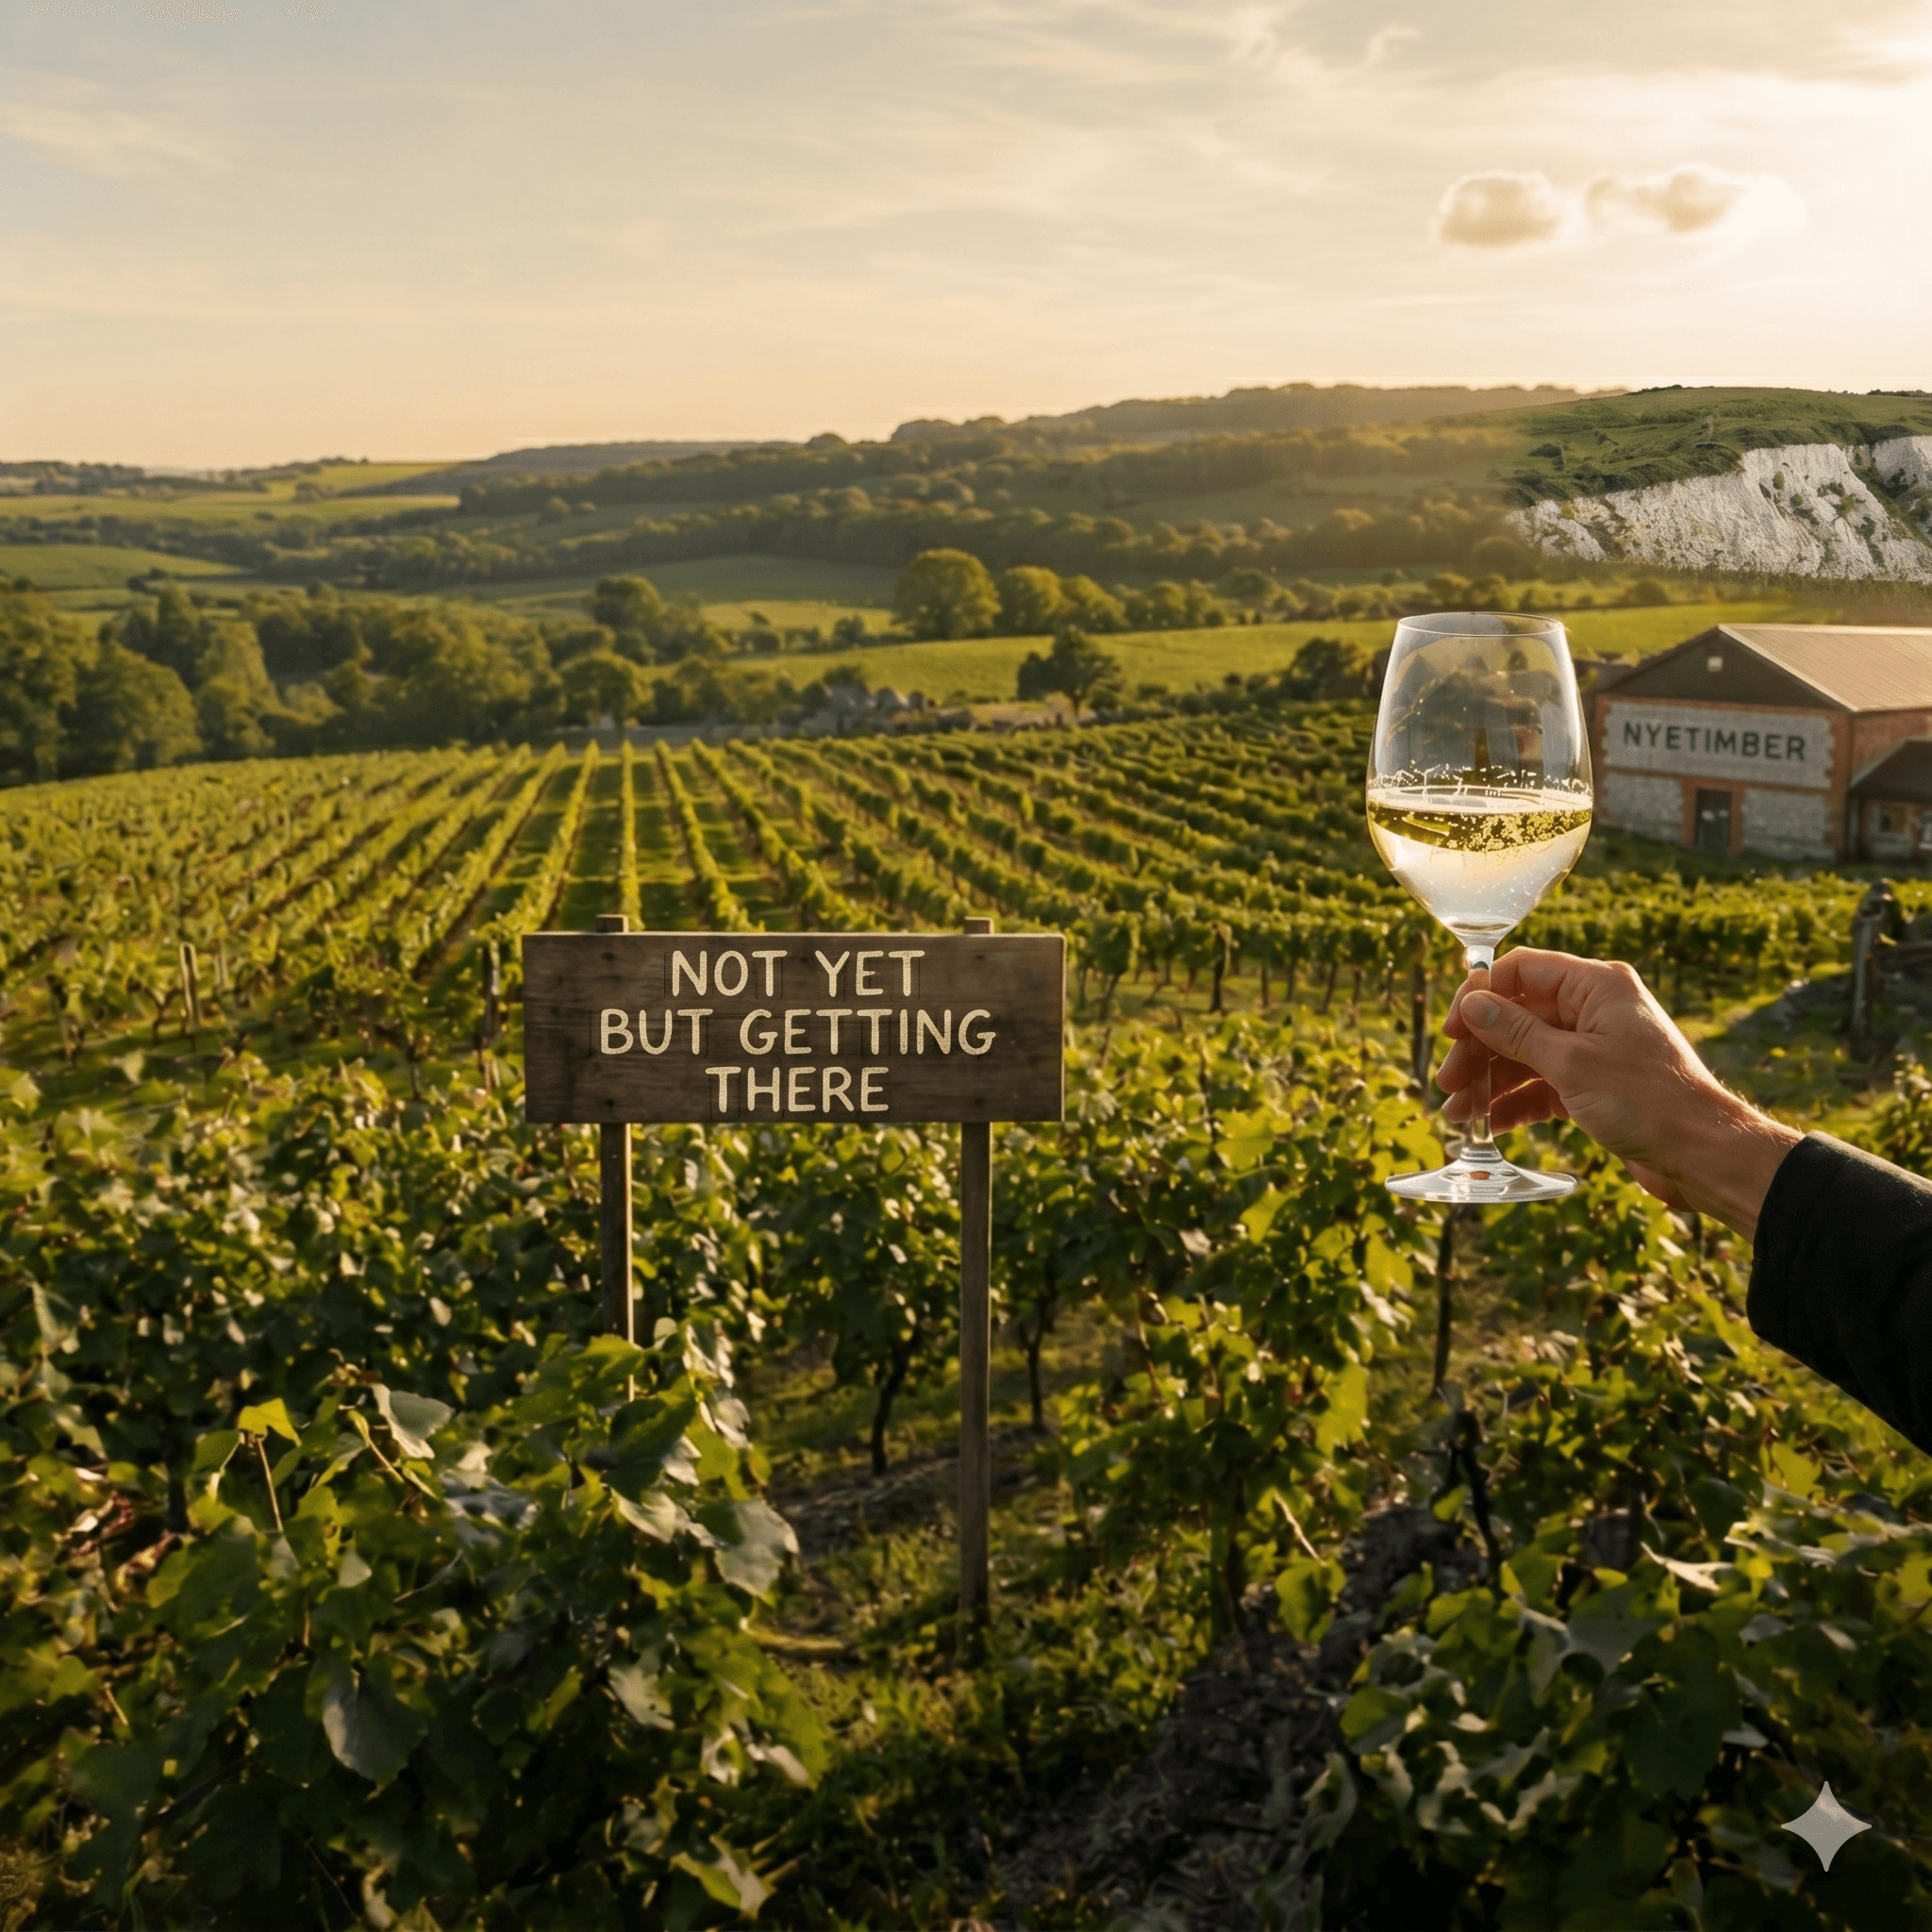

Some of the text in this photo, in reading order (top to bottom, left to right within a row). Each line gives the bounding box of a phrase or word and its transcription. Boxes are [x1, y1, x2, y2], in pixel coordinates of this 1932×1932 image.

[1623, 722, 1807, 761] NYETIMBER
[671, 950, 925, 997] NOT YET
[600, 1008, 997, 1055] BUT GETTING
[705, 1066, 890, 1113] THERE
